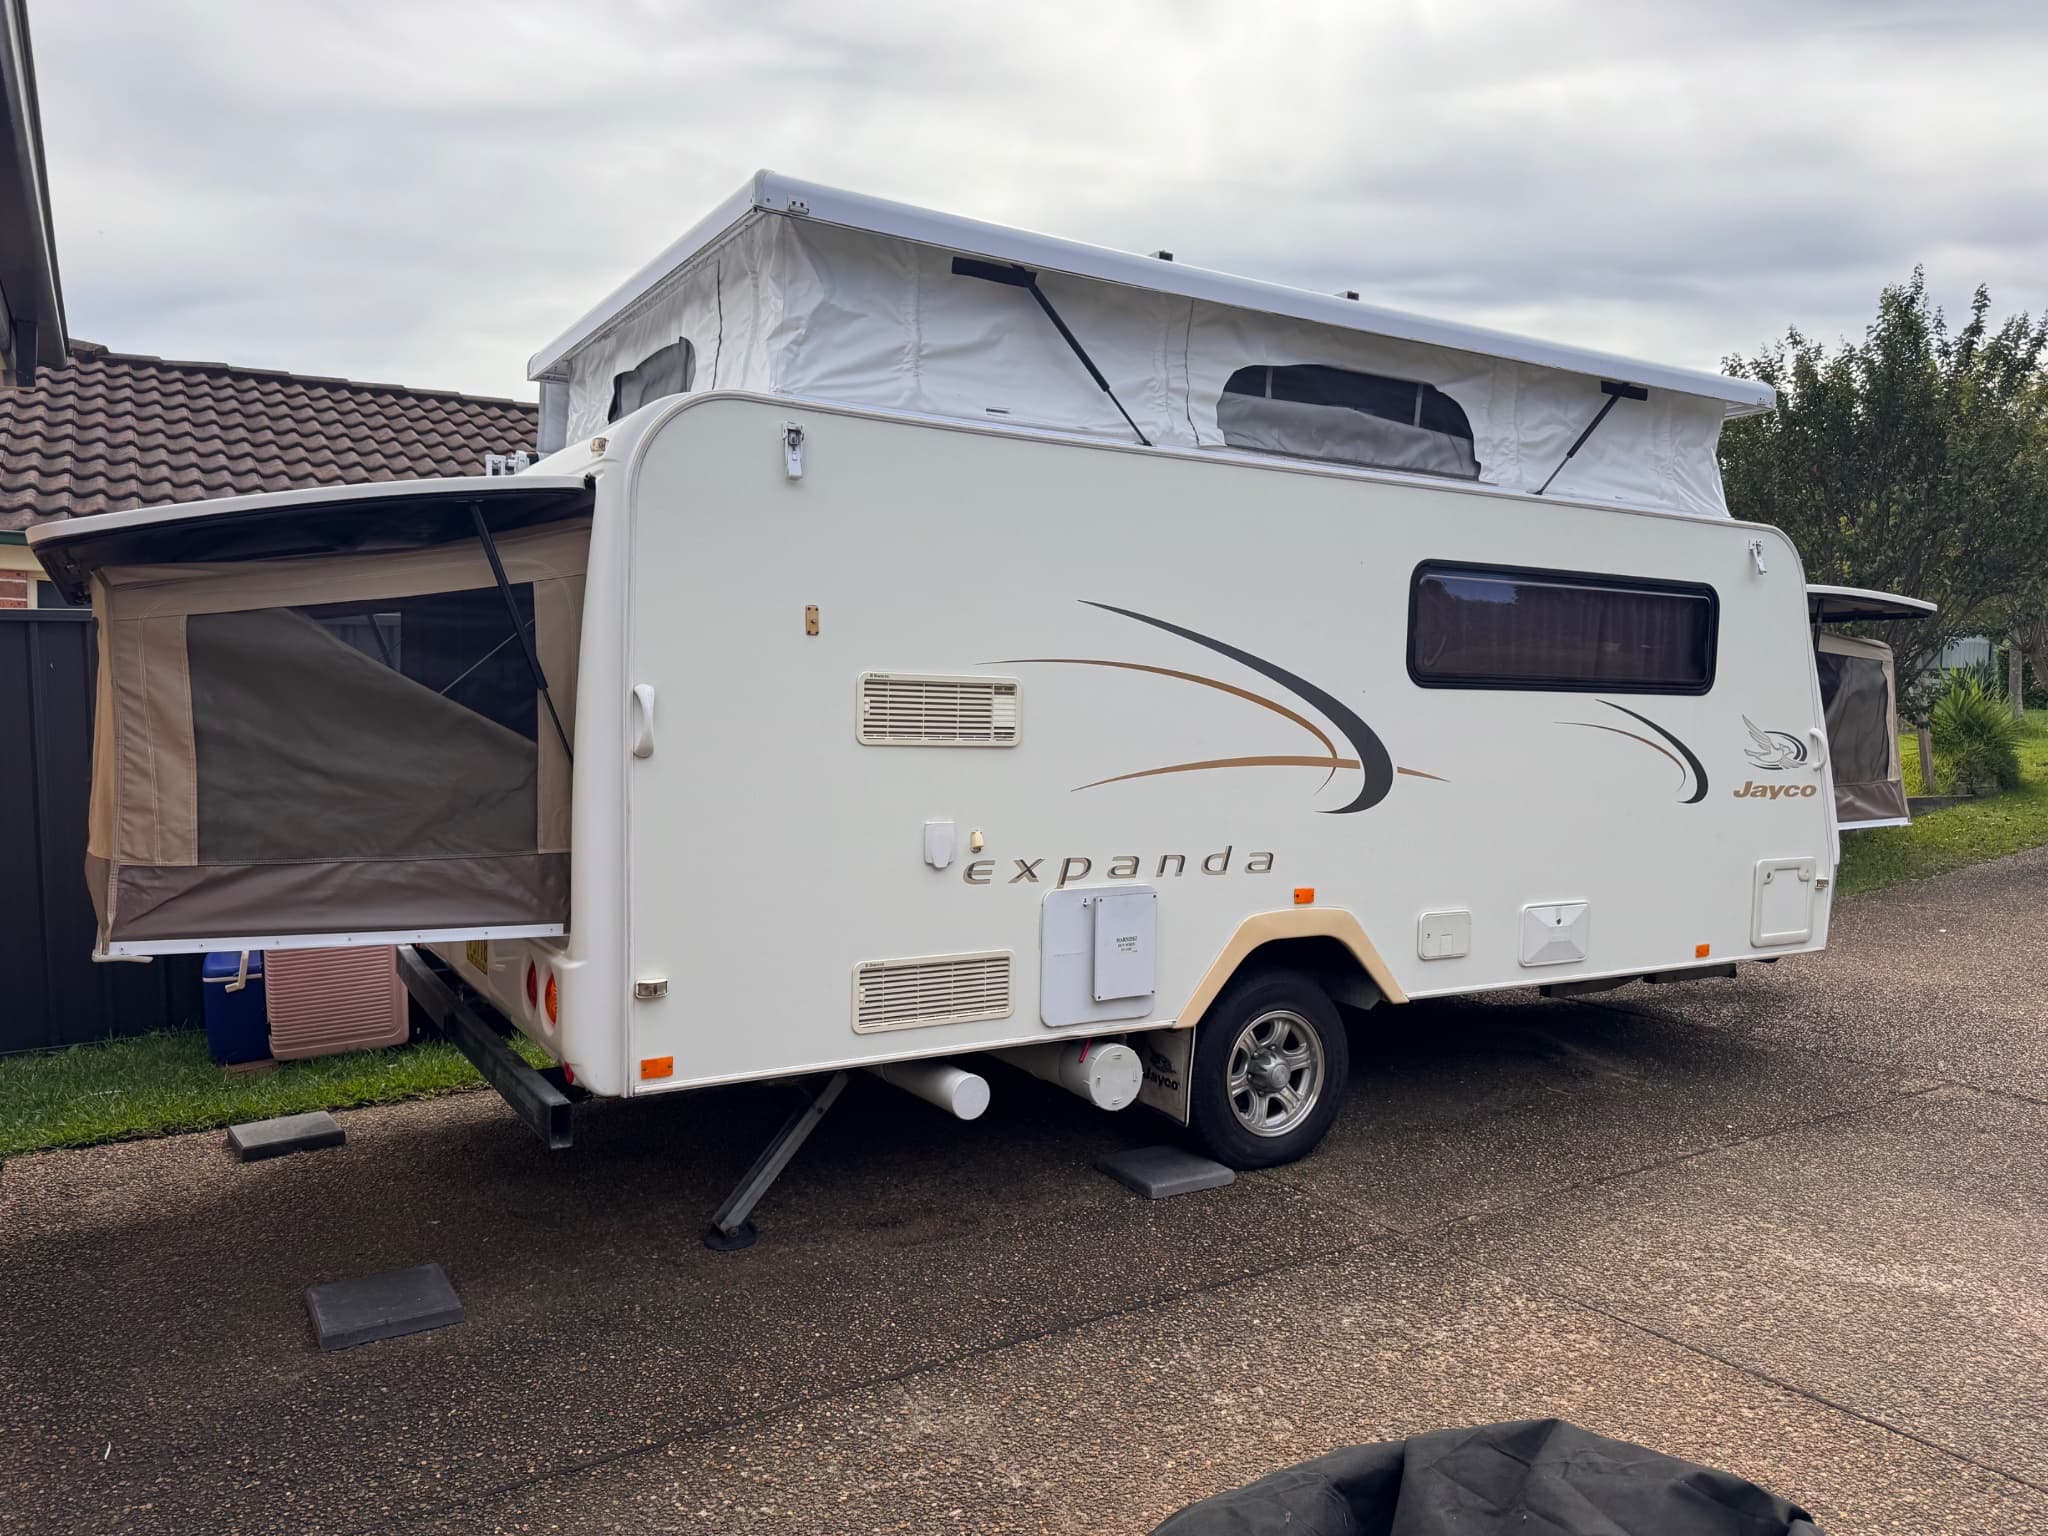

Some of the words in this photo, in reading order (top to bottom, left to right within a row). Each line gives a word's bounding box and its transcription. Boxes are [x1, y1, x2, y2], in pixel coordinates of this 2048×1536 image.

[1733, 781, 1817, 800] Jayco
[963, 845, 1275, 889] expanda
[1143, 1067, 1179, 1091] Jayco
